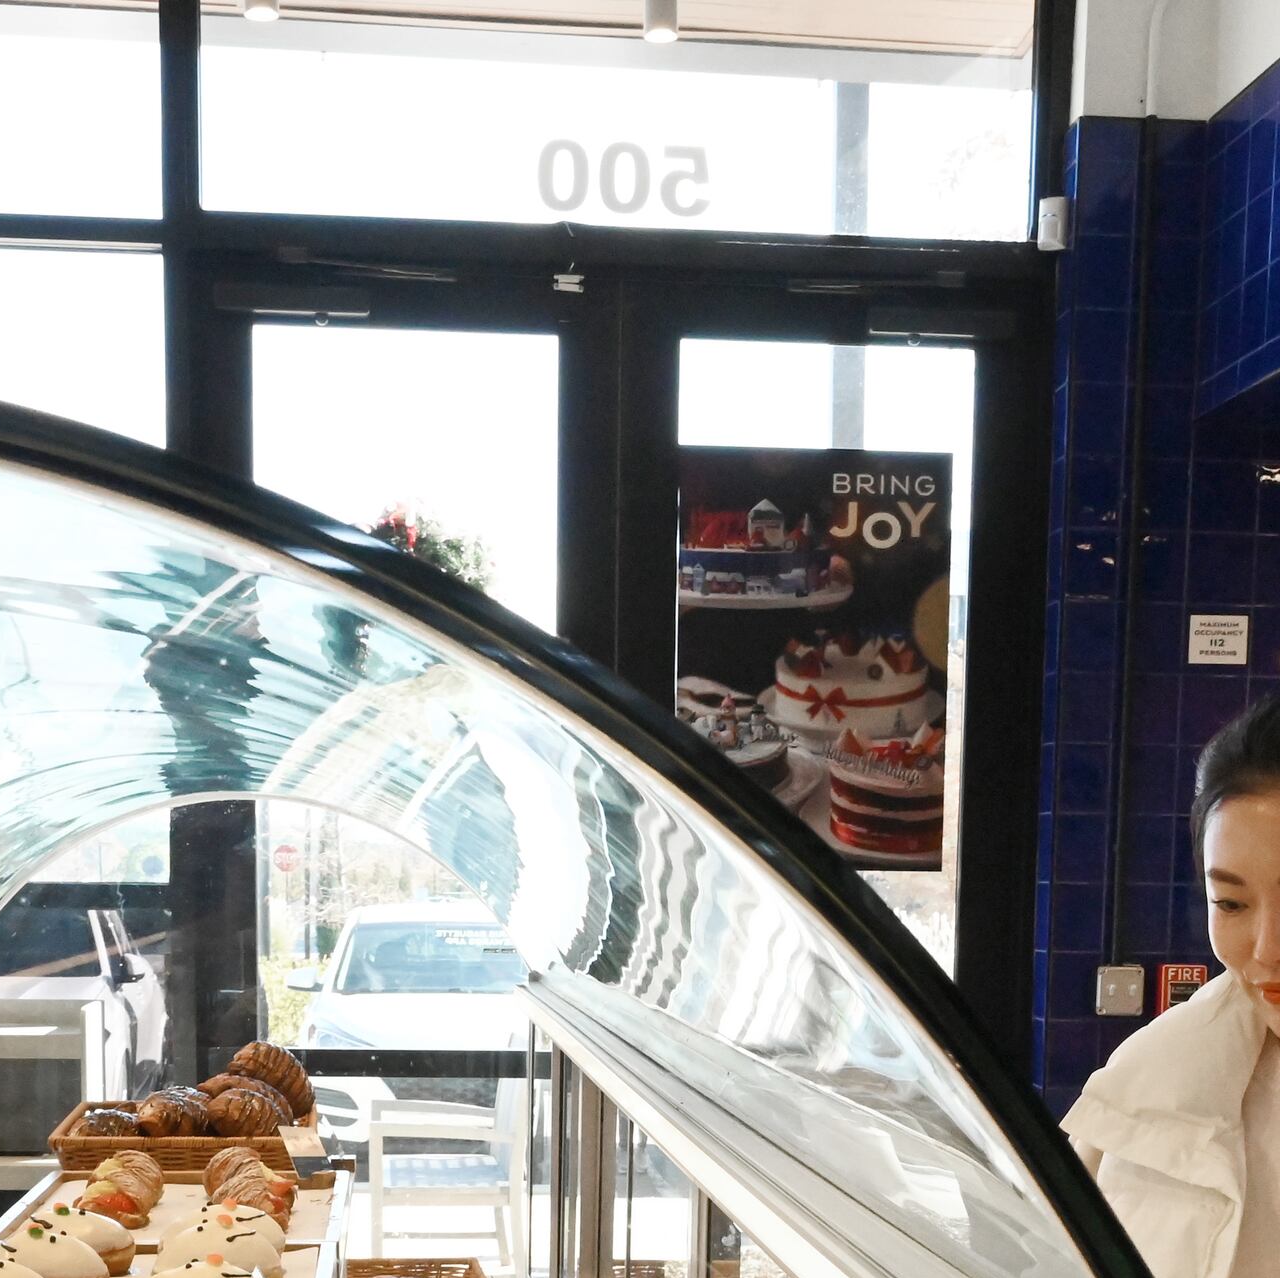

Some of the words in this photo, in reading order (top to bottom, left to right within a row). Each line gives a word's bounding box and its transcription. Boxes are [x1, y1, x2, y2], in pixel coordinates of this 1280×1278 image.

[832, 473, 936, 496] BRING
[828, 501, 937, 549] JOY
[1209, 638, 1225, 647] 112
[1168, 967, 1201, 981] FIRE
